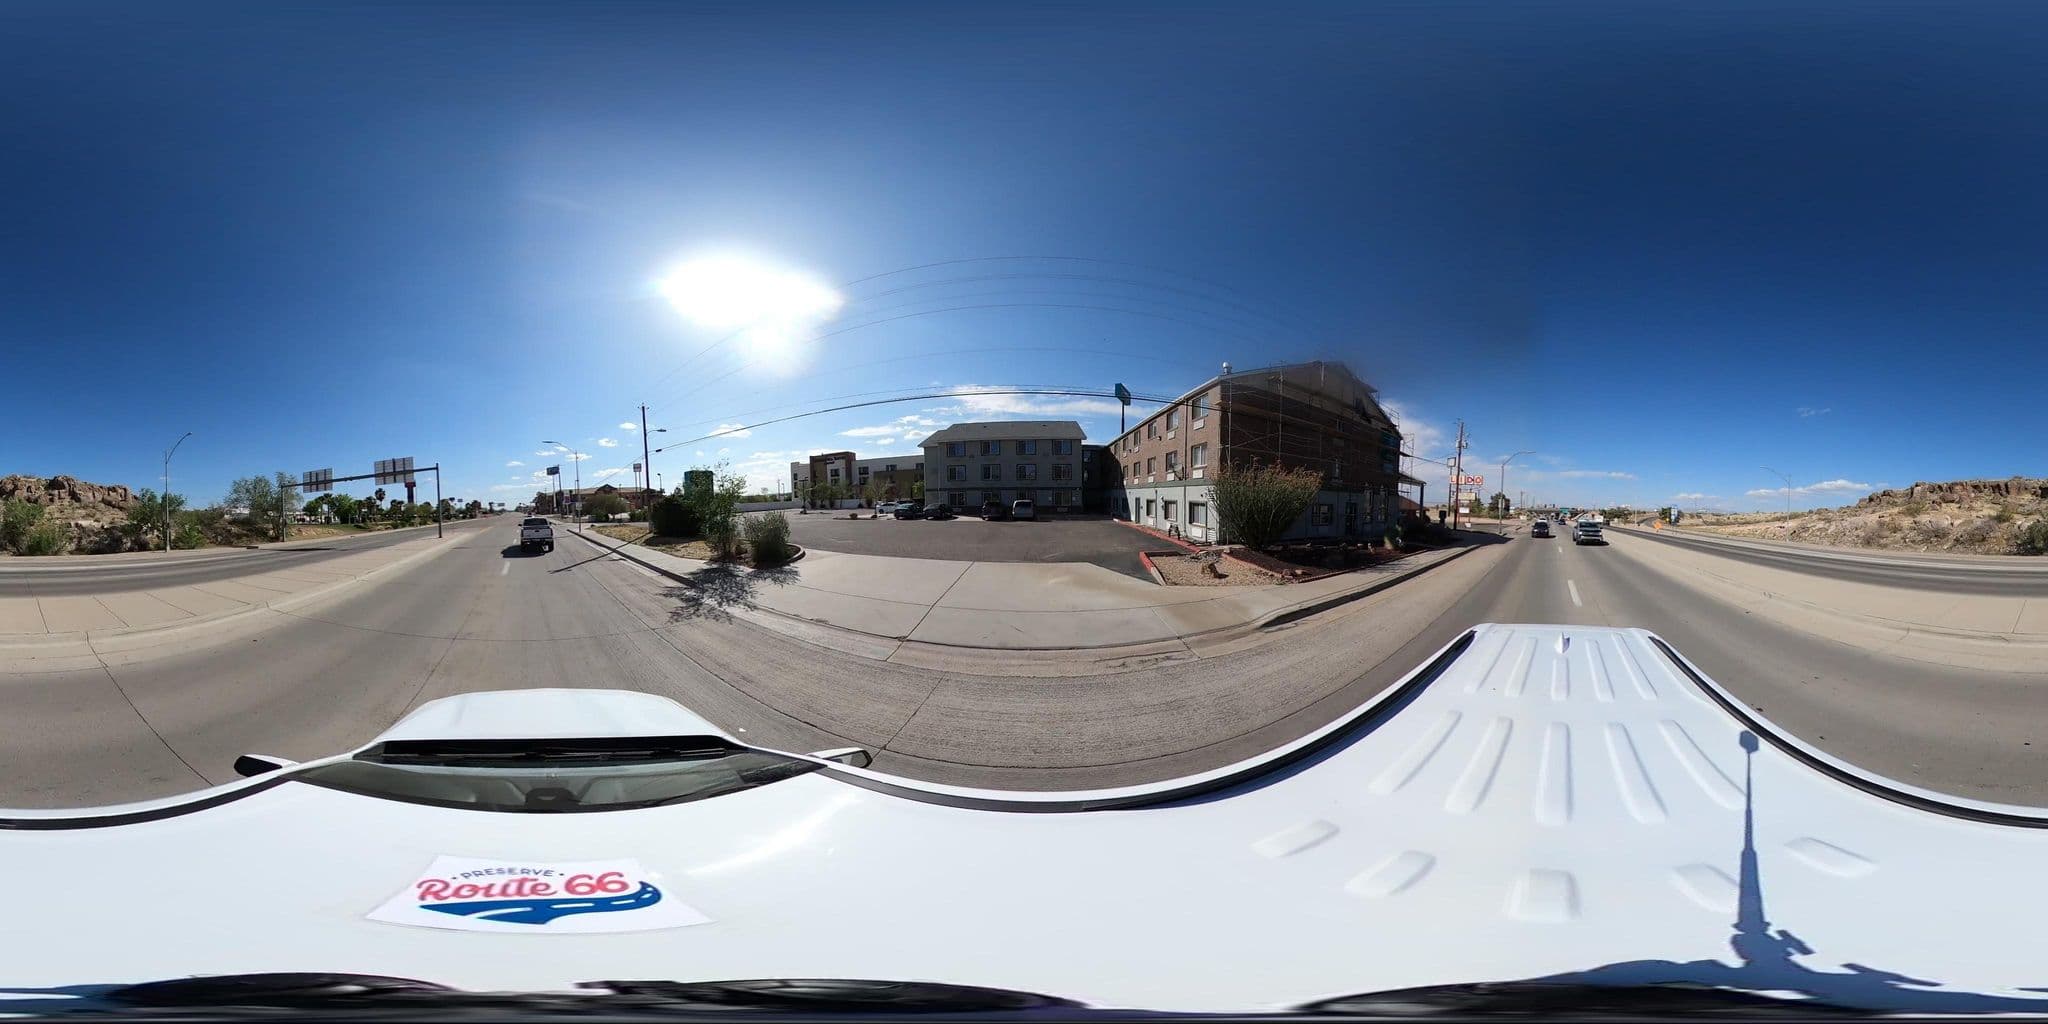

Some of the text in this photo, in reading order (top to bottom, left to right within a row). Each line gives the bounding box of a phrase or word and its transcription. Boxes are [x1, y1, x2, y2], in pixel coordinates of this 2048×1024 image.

[460, 867, 554, 879] PRESERVE
[416, 871, 629, 901] Route 66
